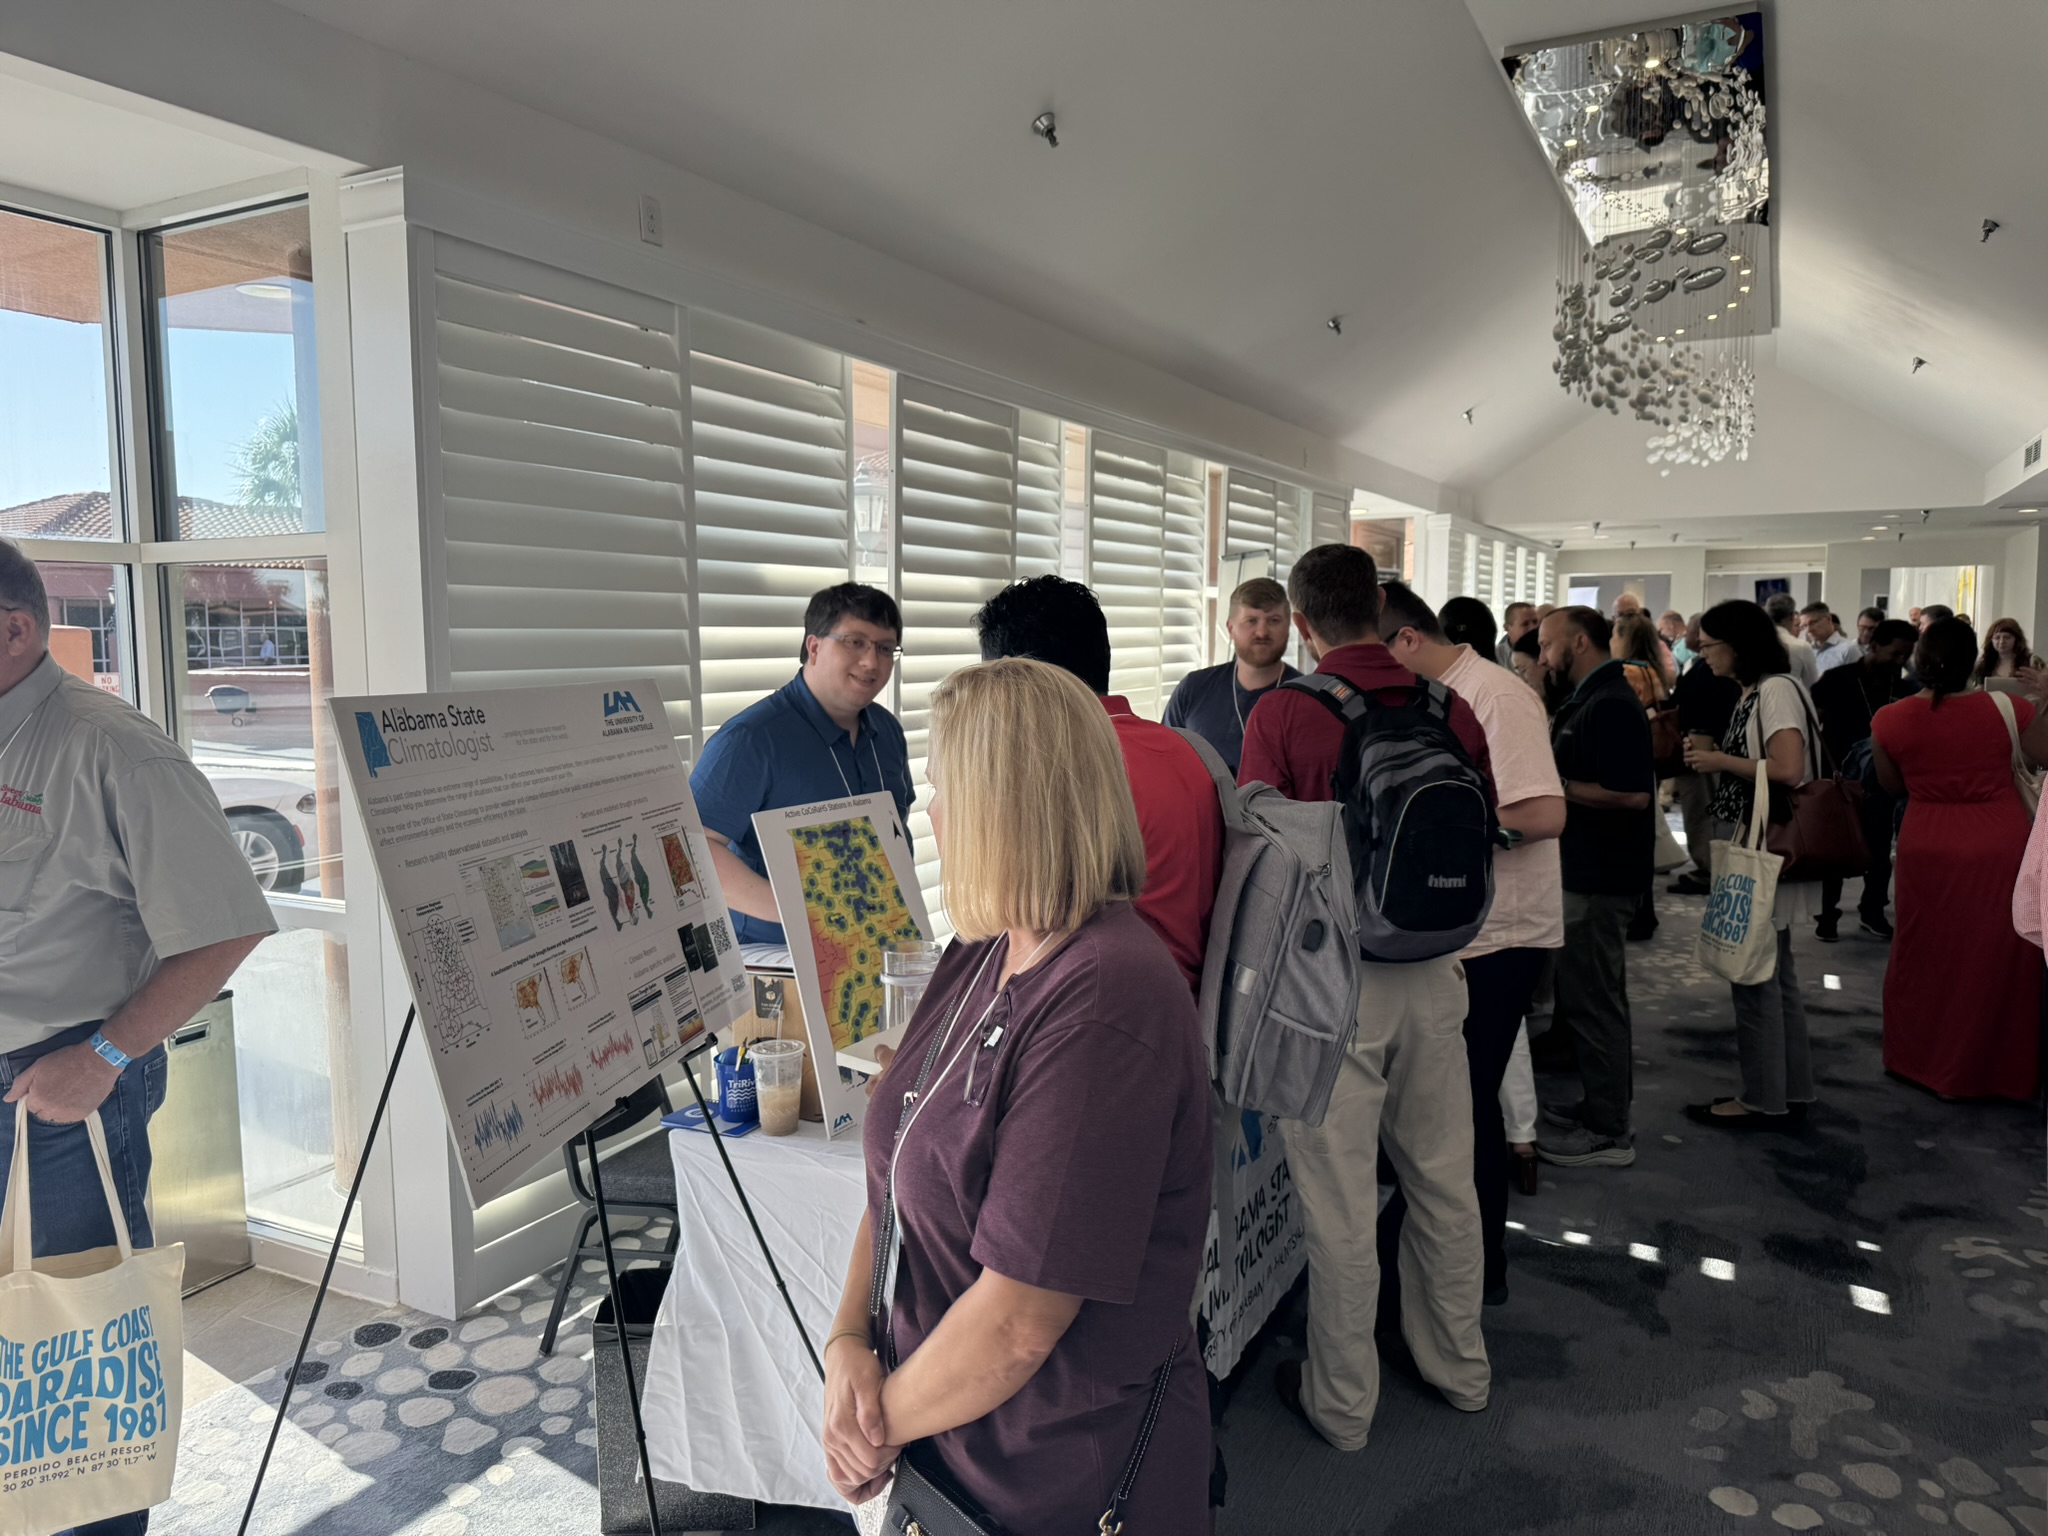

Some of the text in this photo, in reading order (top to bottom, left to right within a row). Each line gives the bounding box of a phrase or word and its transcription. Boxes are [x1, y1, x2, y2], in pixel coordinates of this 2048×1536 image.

[381, 705, 486, 733] Alabama State
[602, 728, 623, 736] ALABAMA
[629, 723, 654, 732] HUNTSVILLE
[614, 716, 638, 725] UNIVERSITY
[388, 730, 495, 765] Climatologist
[0, 791, 41, 814] labama
[785, 809, 801, 819] Active
[828, 802, 847, 812] Stations
[405, 855, 429, 868] Research
[429, 850, 447, 863] quality
[448, 842, 481, 856] observational
[482, 836, 501, 847] datasets
[501, 834, 510, 842] and
[510, 829, 528, 840] analysis
[728, 1078, 755, 1089] TriRiv
[32, 1329, 94, 1375] GULF
[101, 1305, 154, 1353] COAST
[104, 1389, 166, 1443] 1987
[3, 1483, 17, 1493] 30
[77, 1467, 85, 1475] N
[91, 1463, 103, 1472] 87
[147, 1452, 157, 1461] W
[4, 1442, 156, 1481] PERDIDO BEACH RESORT
